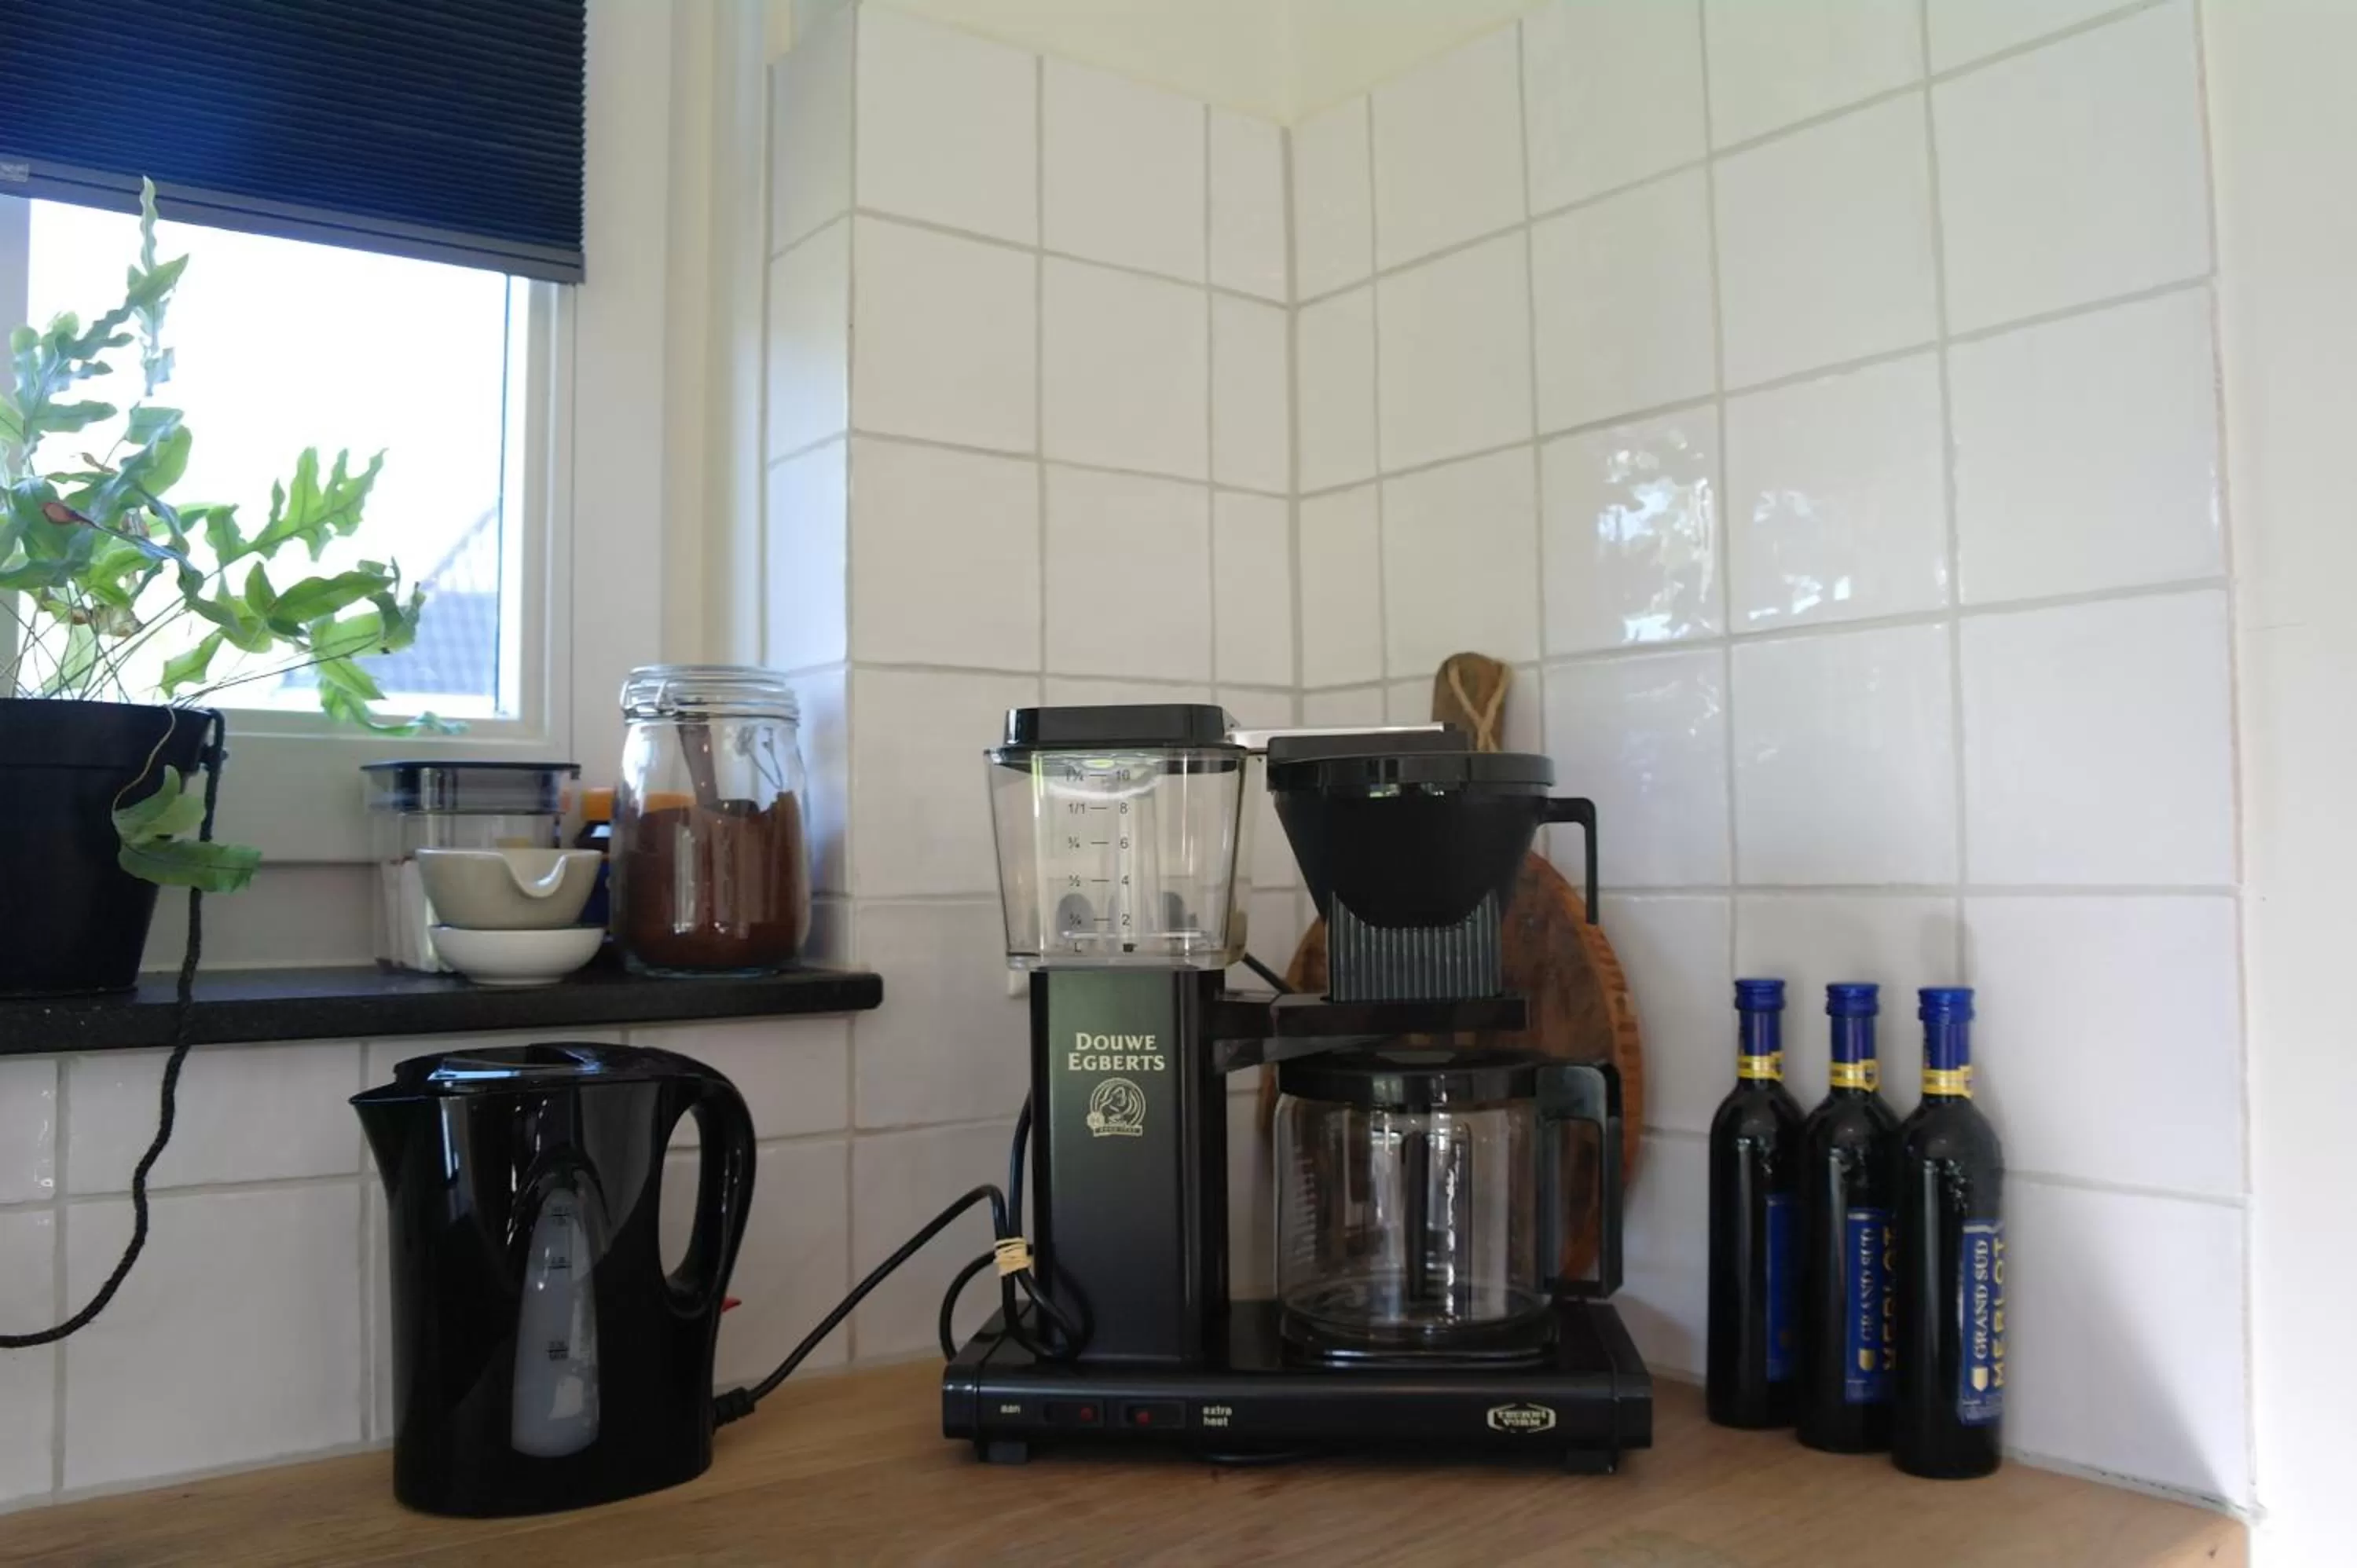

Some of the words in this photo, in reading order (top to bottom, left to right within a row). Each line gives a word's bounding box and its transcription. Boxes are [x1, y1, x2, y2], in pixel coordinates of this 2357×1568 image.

[1116, 769, 1131, 781] 10
[1120, 802, 1128, 814] 8
[1120, 837, 1129, 849] 6
[1120, 875, 1129, 886] 4
[1122, 914, 1131, 925] 2
[1075, 1032, 1157, 1050] DOUWE
[1068, 1053, 1165, 1071] EGBERTS
[1973, 1240, 1989, 1280] SUD
[1973, 1284, 1989, 1360] GRAND
